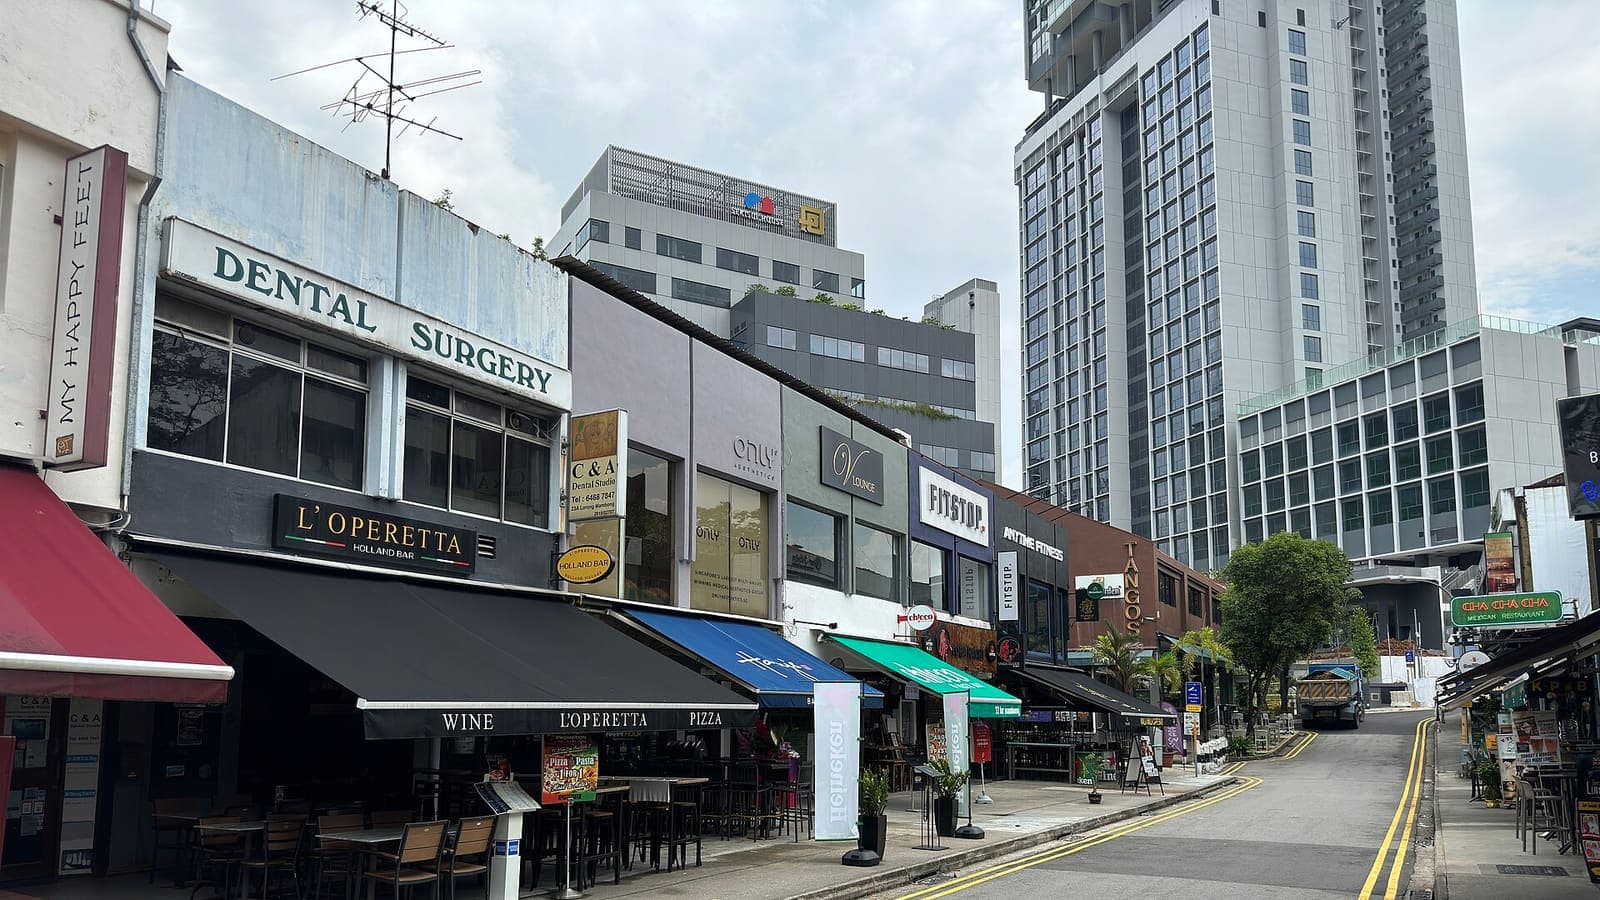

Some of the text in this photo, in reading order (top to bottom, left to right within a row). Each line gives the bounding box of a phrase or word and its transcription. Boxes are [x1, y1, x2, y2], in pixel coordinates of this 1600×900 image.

[60, 162, 93, 424] MY HAPPY FEET
[213, 246, 552, 394] DENTAL SURGERY
[572, 459, 614, 479] C & A
[833, 442, 876, 494] V LOUNGE
[572, 478, 616, 491] Dental Studio
[353, 544, 414, 560] HOLLAND BAR
[1003, 526, 1064, 562] ANYTIME FITNESS
[559, 560, 608, 570] HOLLAND BAR
[1004, 562, 1013, 610] FITSTOP.
[1124, 540, 1140, 635] TANGOS
[1462, 598, 1549, 612] CHA CHA CHA
[1467, 610, 1545, 622] MEXICAN RESTAURANT
[70, 714, 78, 722] C
[92, 714, 100, 722] A
[442, 713, 494, 731] WINE
[560, 712, 648, 728] L'OPERETTA
[690, 711, 722, 726] PIZZA
[576, 756, 594, 766] Pasta
